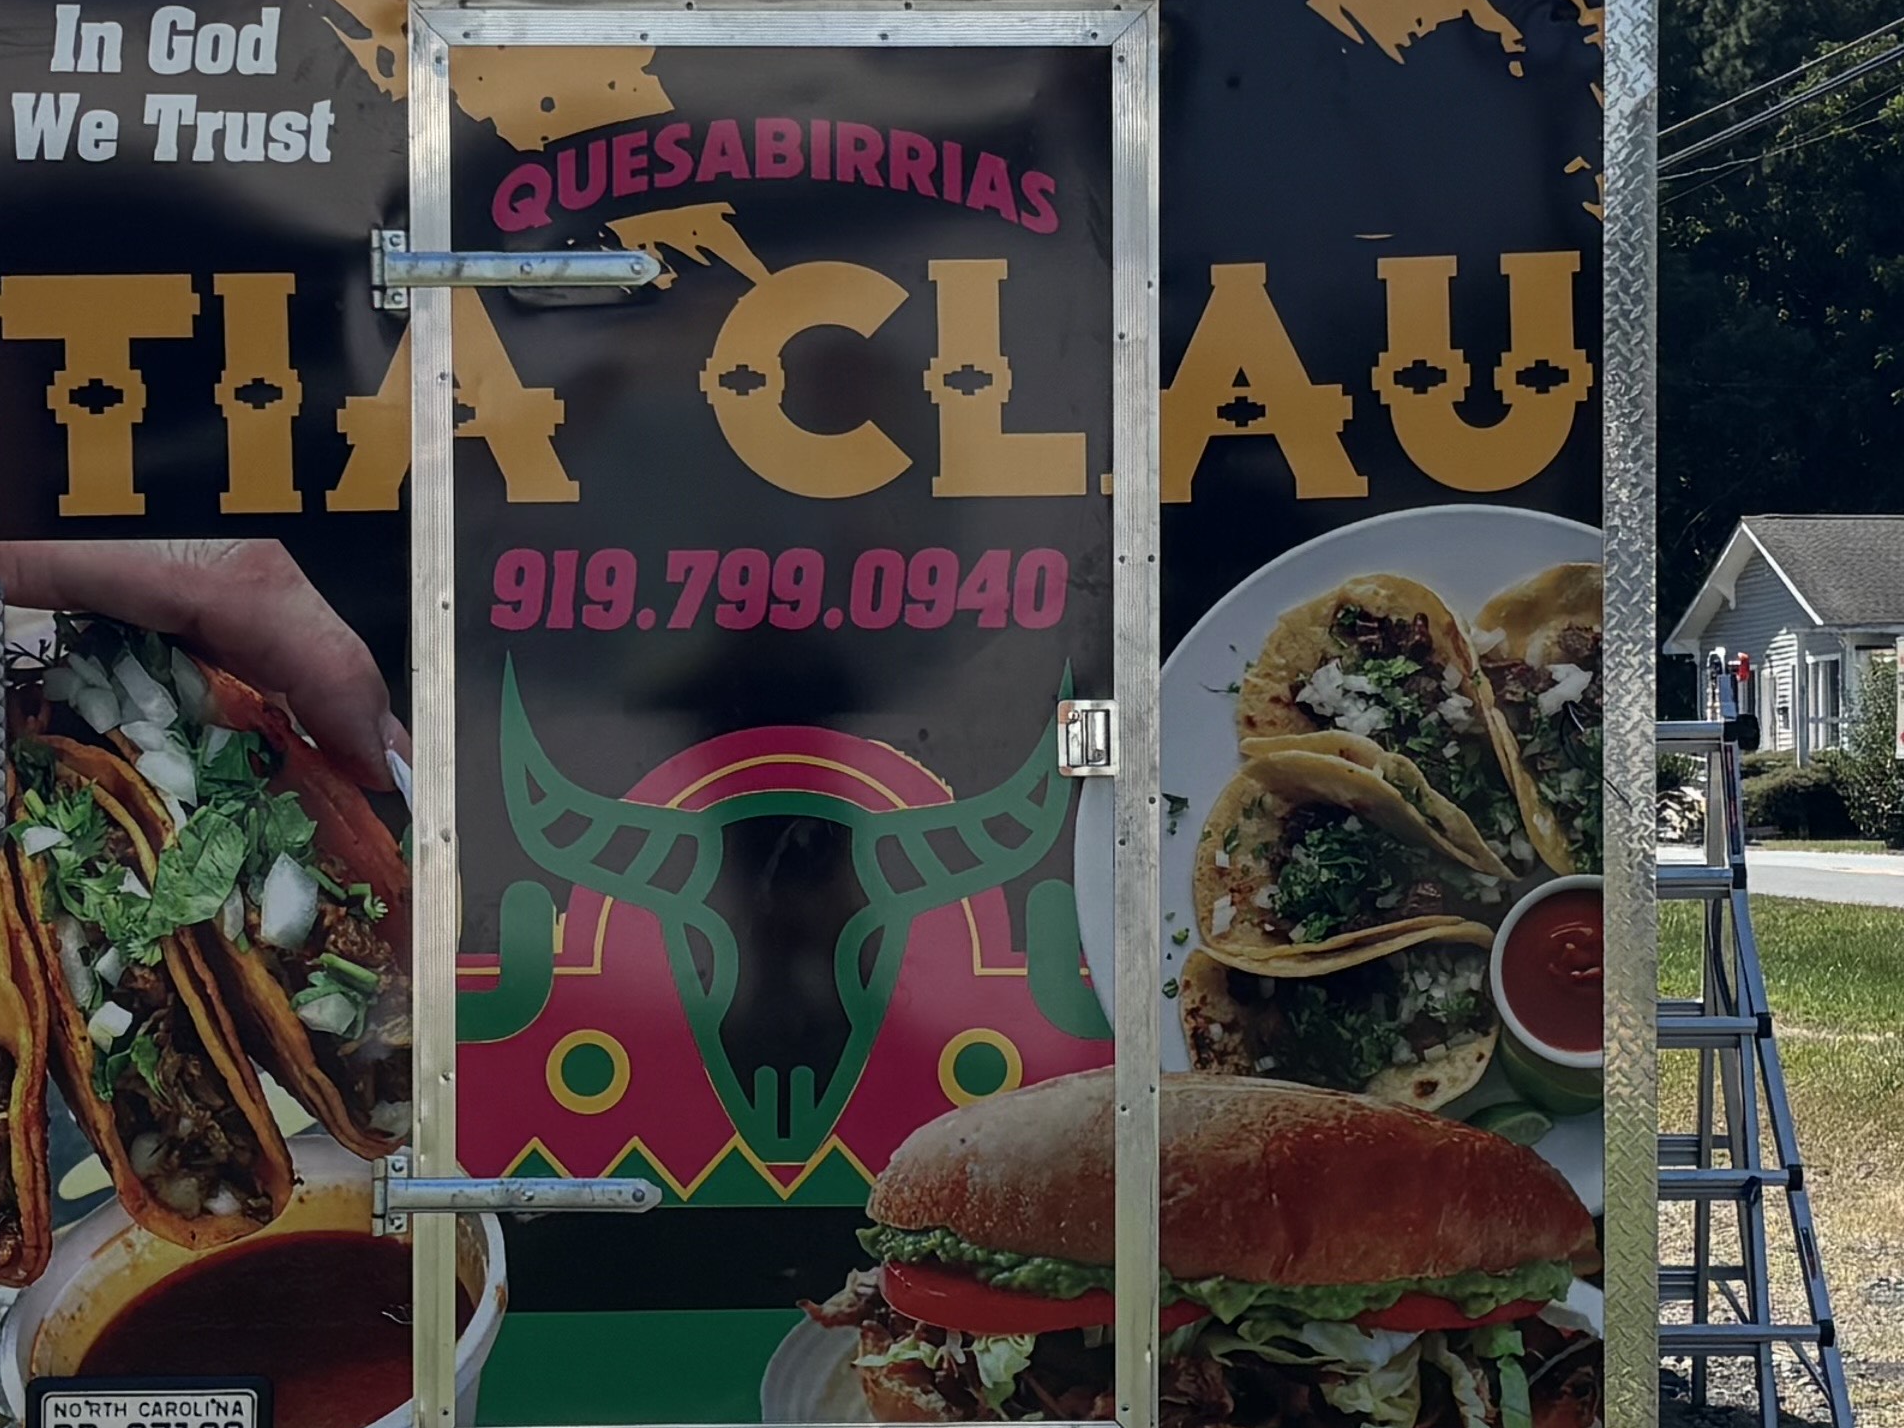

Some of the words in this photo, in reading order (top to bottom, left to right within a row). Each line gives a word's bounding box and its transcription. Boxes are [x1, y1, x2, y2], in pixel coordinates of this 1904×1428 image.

[50, 3, 124, 73] In
[148, 5, 281, 75] God
[11, 92, 120, 163] We
[144, 93, 335, 164] Trust
[490, 117, 1059, 234] QUESABIRRIAS
[699, 251, 1593, 503] CLAU
[489, 547, 1068, 631] 919.799.0940
[54, 1401, 127, 1418] NORTH
[138, 1400, 245, 1417] CAROLINA
